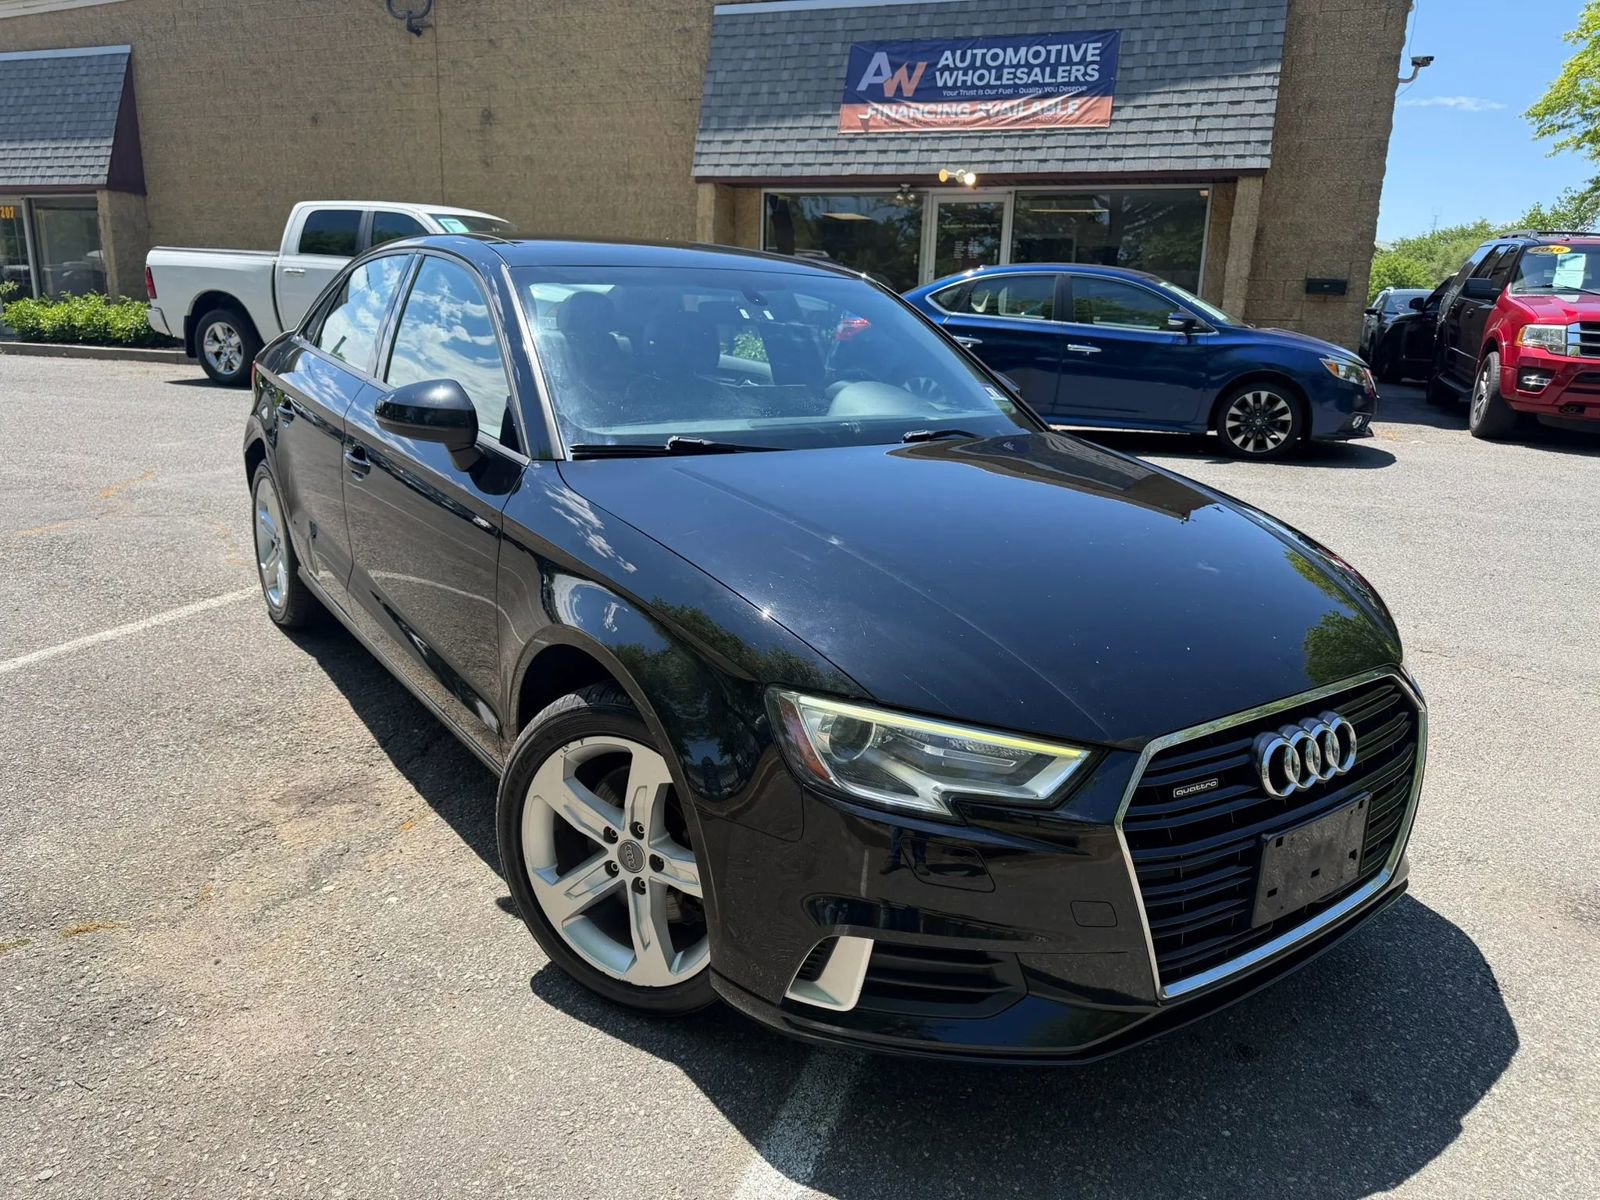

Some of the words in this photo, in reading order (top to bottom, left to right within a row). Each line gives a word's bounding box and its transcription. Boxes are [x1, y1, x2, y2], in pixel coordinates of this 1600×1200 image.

[936, 43, 1102, 68] AUTOMOTIVE
[856, 52, 928, 97] AW
[935, 64, 1100, 87] WHOLESALERS
[959, 88, 977, 96] Trust
[1019, 87, 1042, 95] Quality
[1043, 86, 1058, 94] You
[1059, 85, 1088, 93] Deserve
[858, 103, 971, 119] FINANCING
[973, 101, 1080, 118] AVAILABLE
[1176, 781, 1217, 796] quattro
